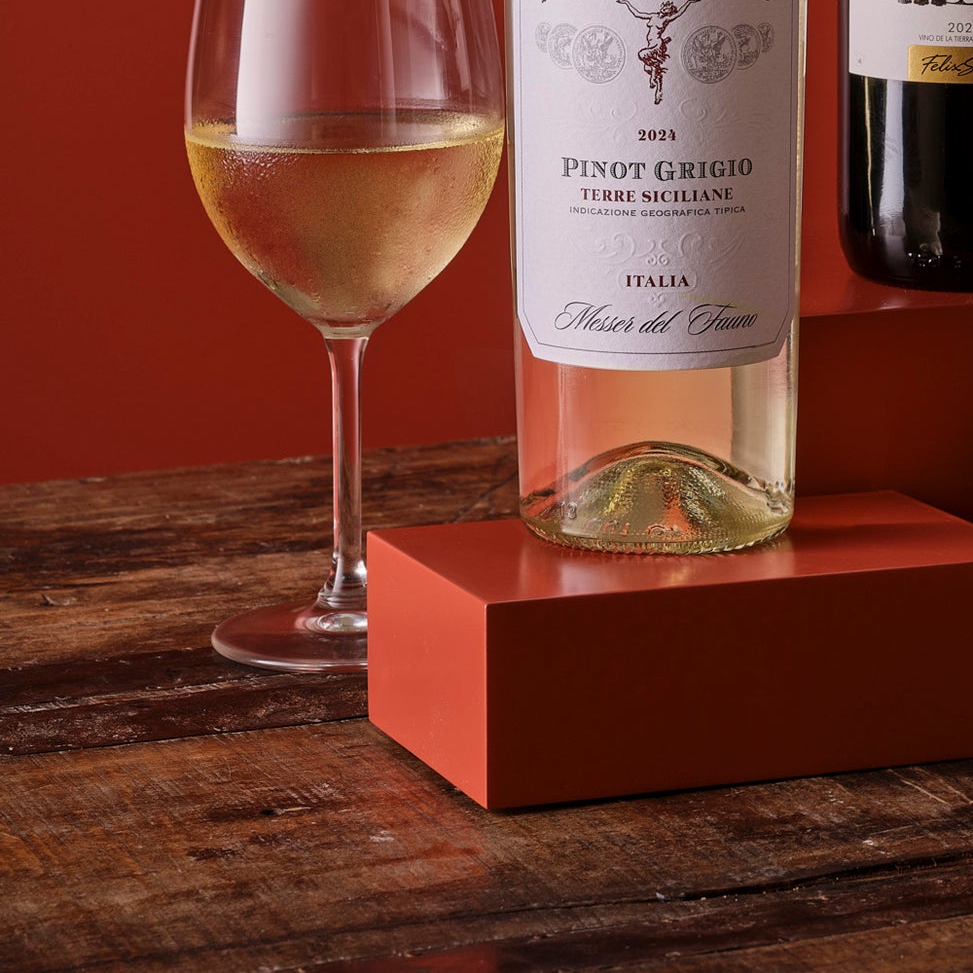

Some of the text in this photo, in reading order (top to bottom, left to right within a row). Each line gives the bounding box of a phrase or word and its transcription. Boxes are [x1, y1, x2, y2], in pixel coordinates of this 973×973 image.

[918, 34, 935, 42] VINO
[935, 34, 944, 43] DE
[945, 35, 953, 43] LA
[953, 35, 973, 43] TIERRA
[637, 128, 678, 142] 2024
[560, 155, 754, 183] PINOT GRIGIO
[579, 187, 734, 204] TERRE SICILIANE
[568, 205, 747, 218] INDICAZIONE GEOGRAFICA TIPICA
[624, 273, 691, 289] ITALIA
[553, 300, 760, 336] Messer del Fauno
